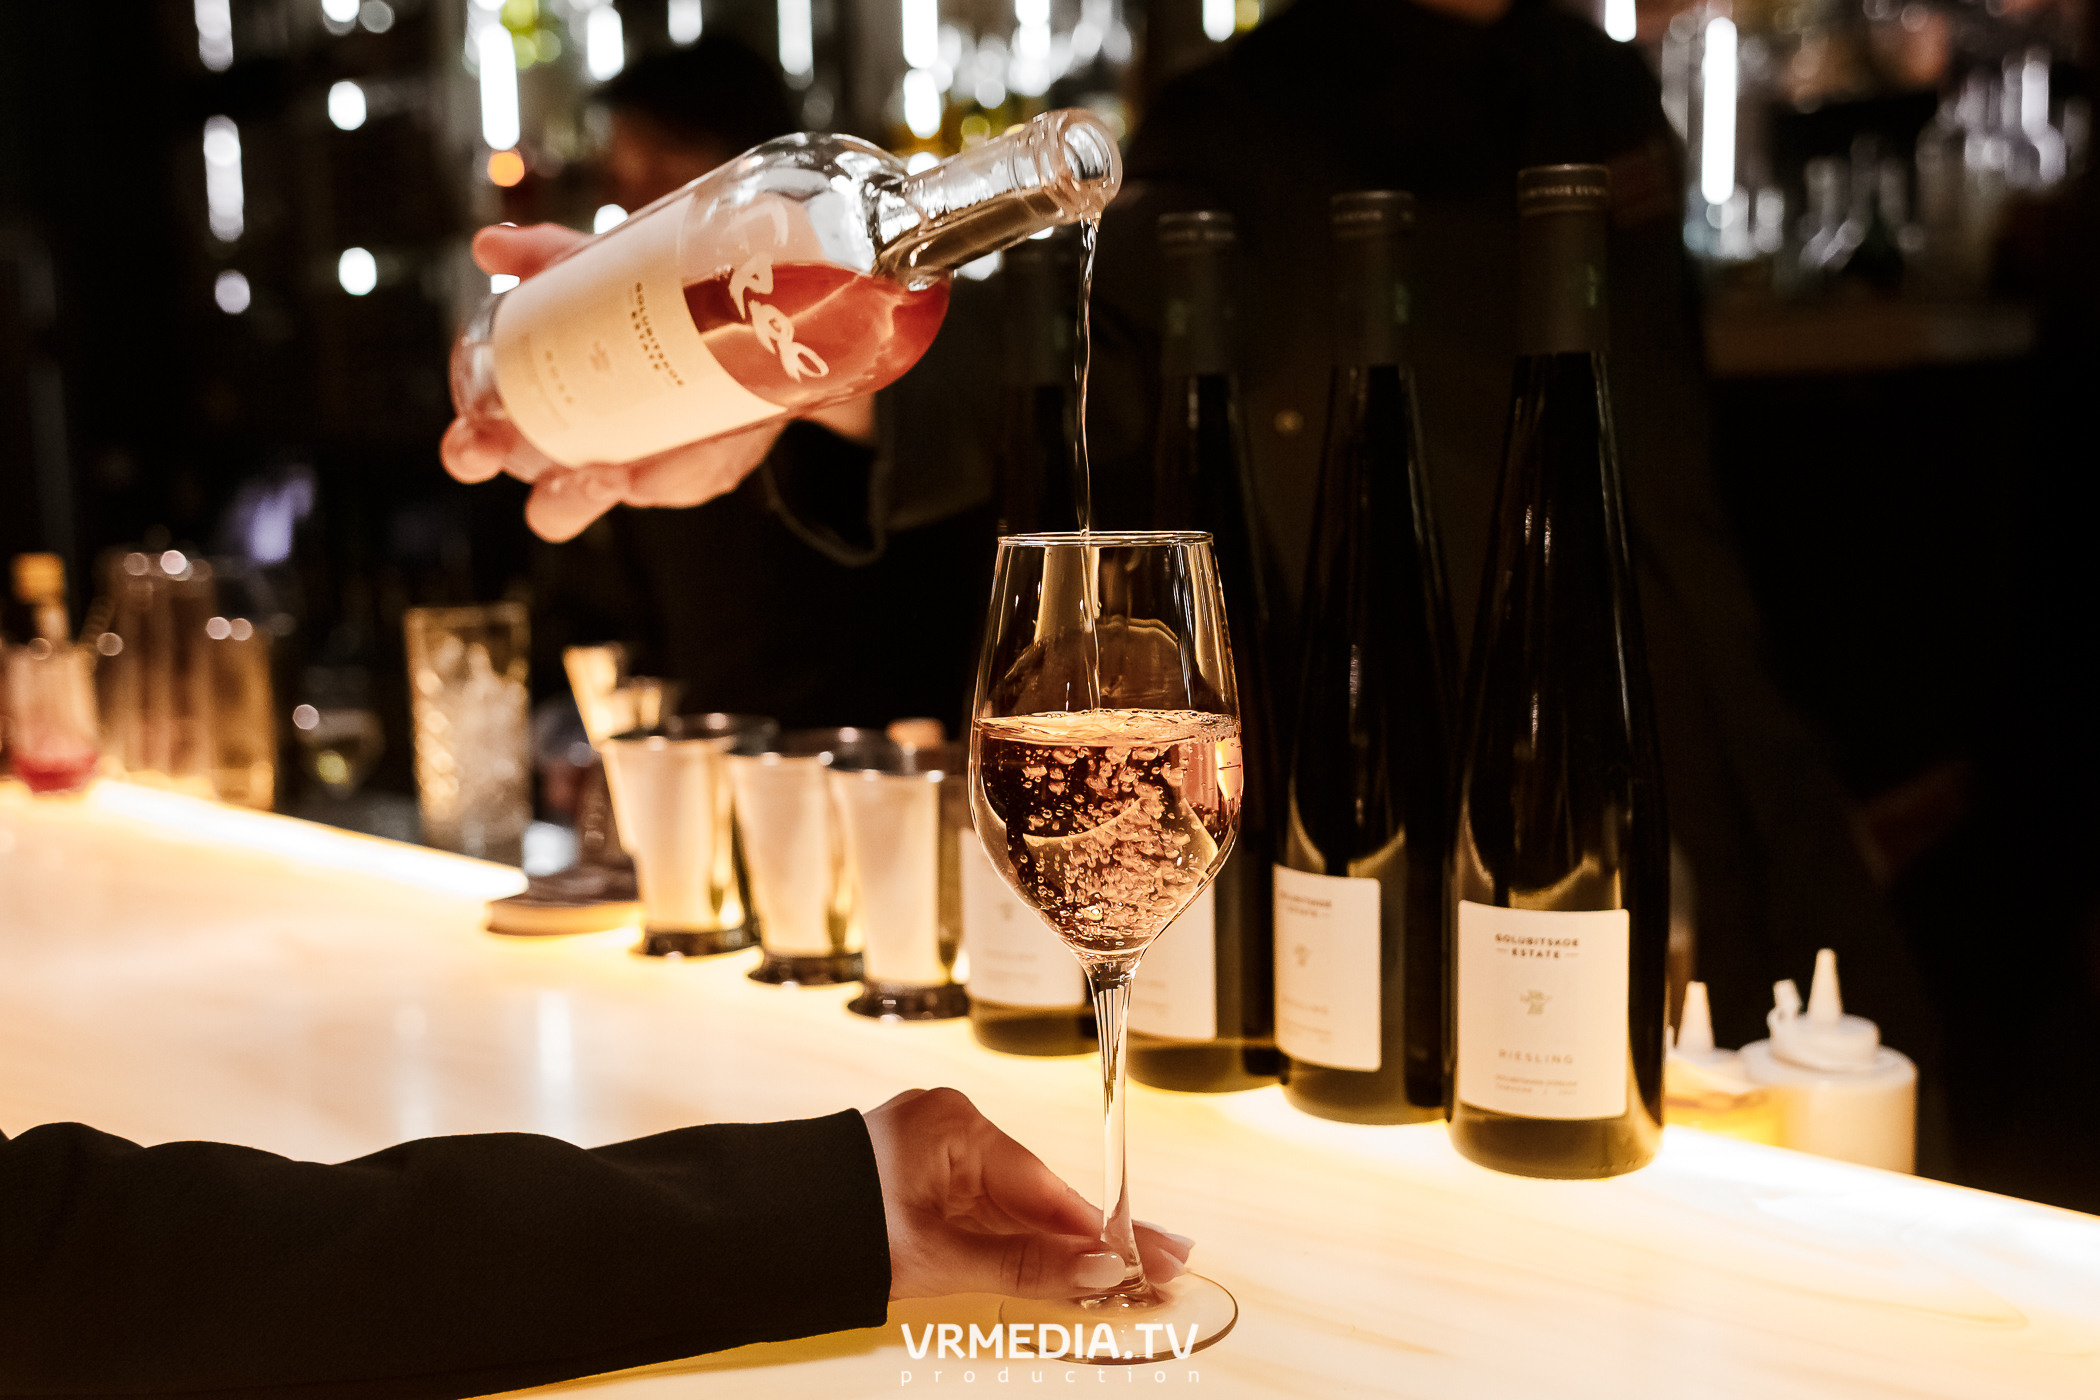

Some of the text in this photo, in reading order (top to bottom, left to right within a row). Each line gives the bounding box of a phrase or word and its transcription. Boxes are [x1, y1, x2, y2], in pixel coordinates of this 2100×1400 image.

[630, 310, 661, 371] ESTATE
[1494, 932, 1580, 948] GOLUBITSKOE
[1511, 948, 1561, 960] ESTATE
[1498, 1048, 1575, 1066] RIESLING
